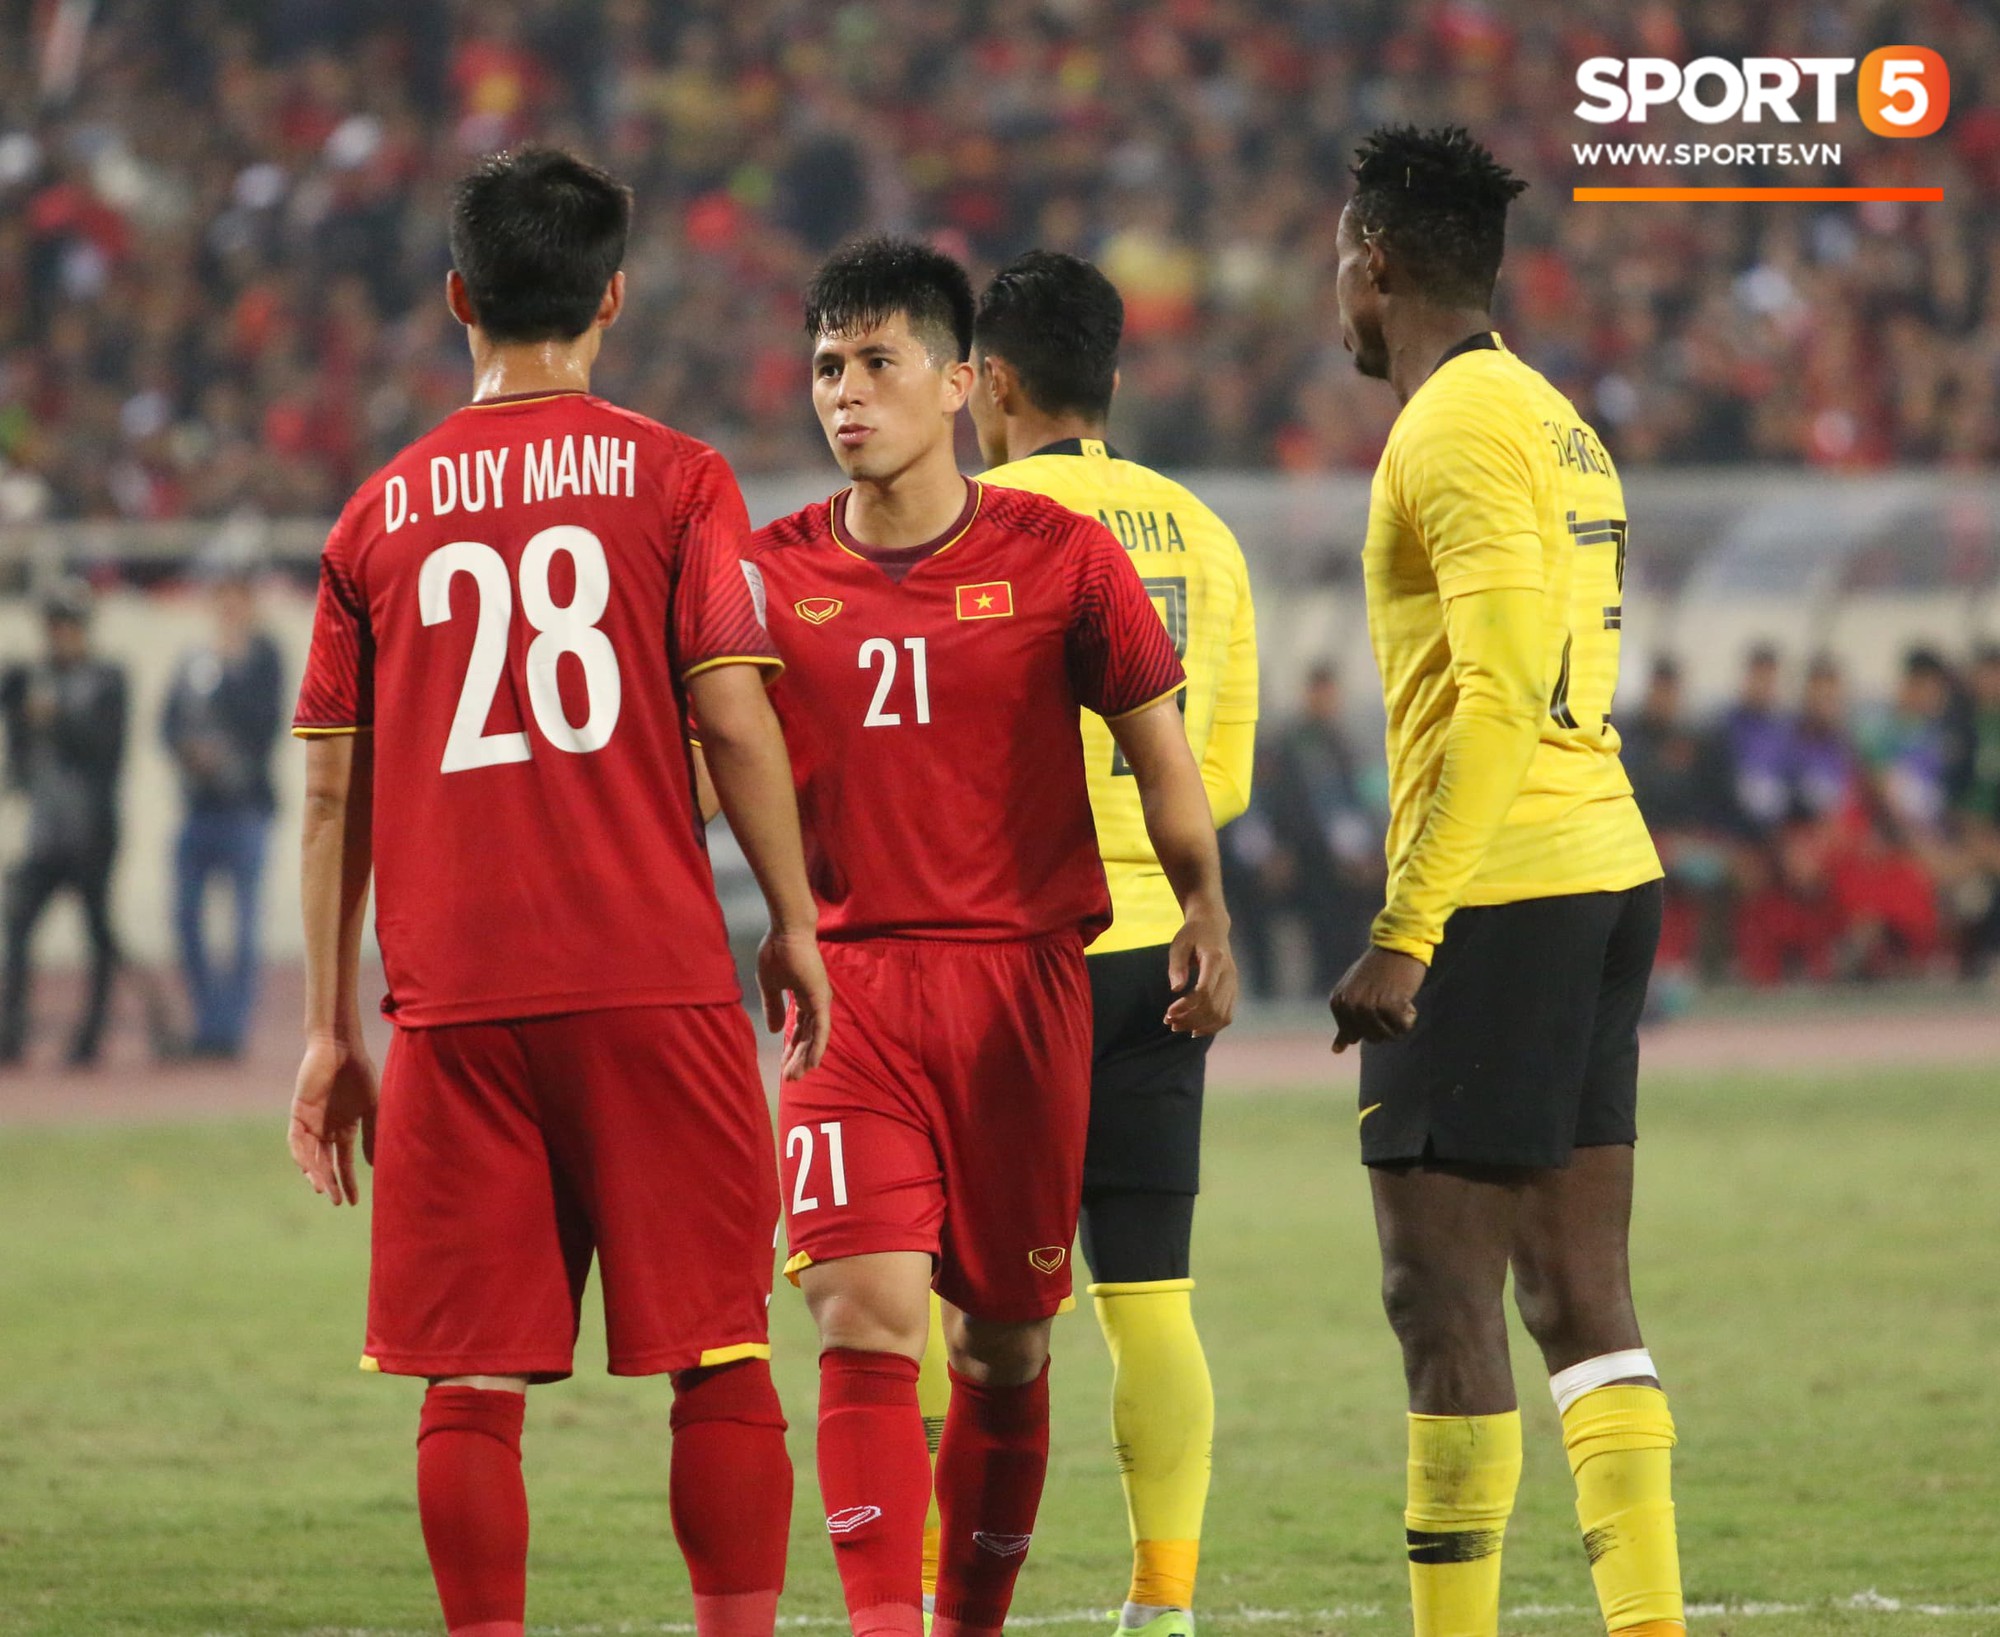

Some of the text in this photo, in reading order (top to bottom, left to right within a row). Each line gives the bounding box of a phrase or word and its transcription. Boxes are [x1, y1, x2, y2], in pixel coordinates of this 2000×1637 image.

[384, 434, 637, 534] D. DUY MANH
[417, 524, 622, 775] 28
[857, 636, 931, 728] 21
[785, 1121, 849, 1217] 21
